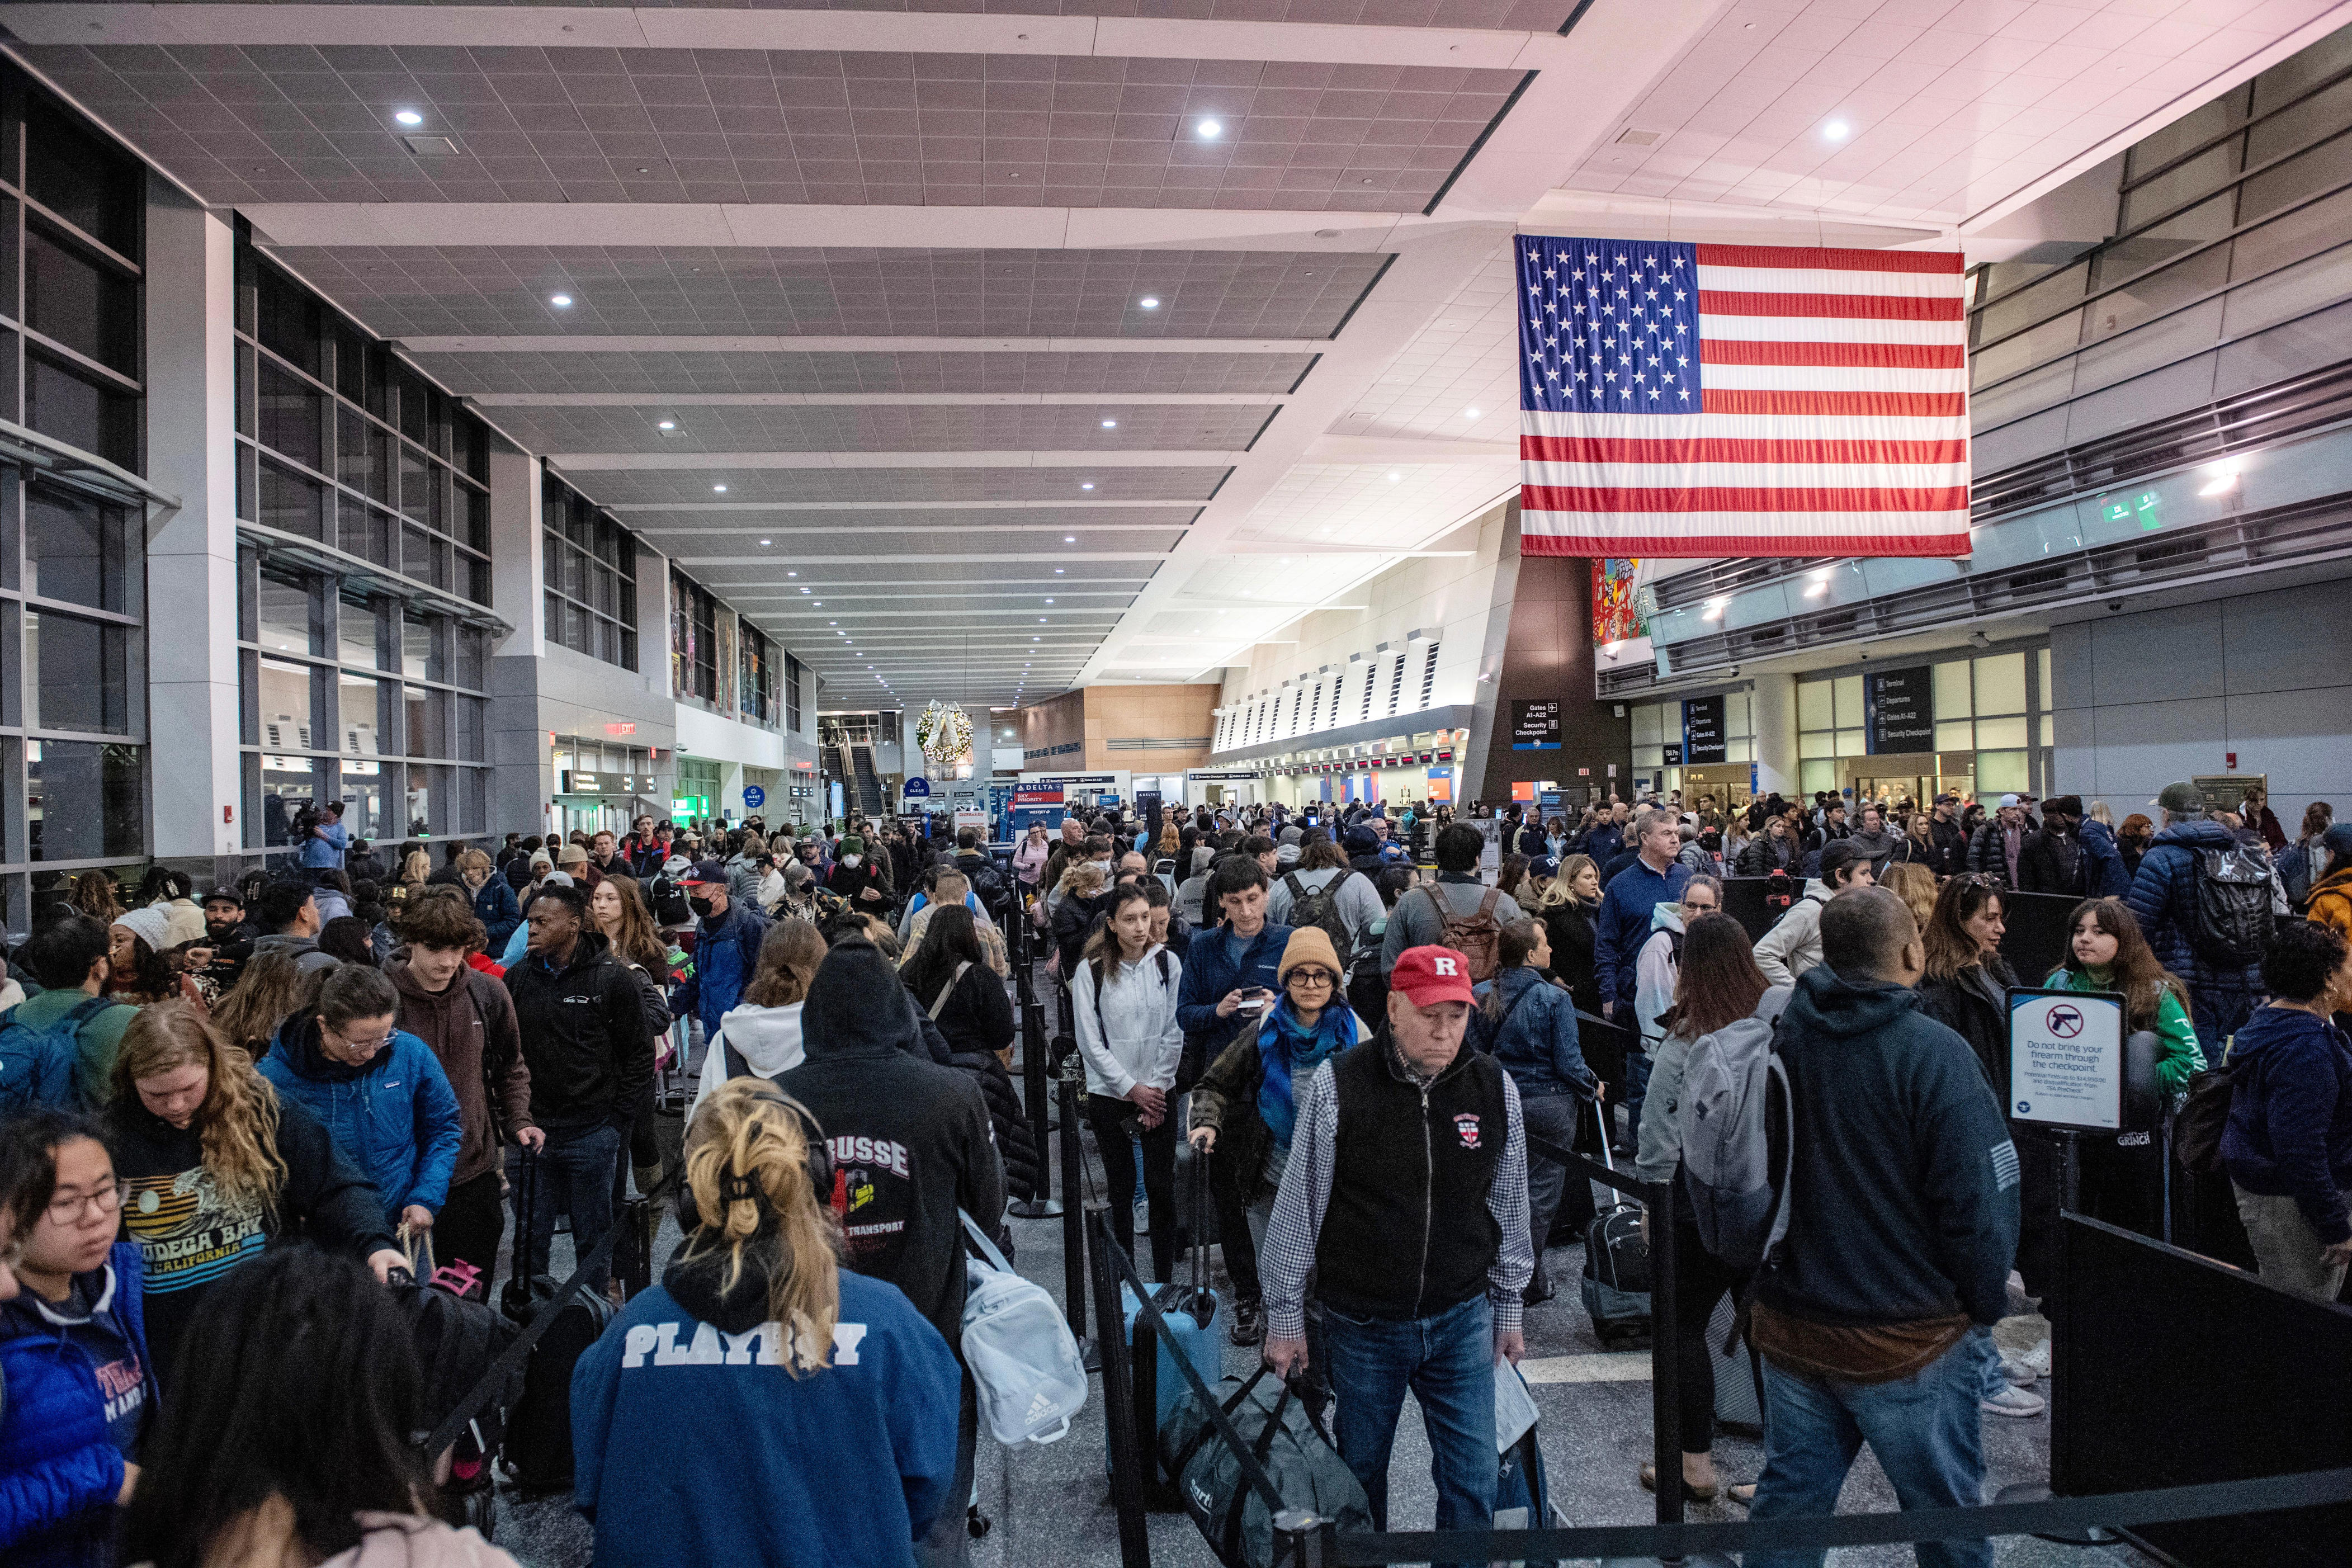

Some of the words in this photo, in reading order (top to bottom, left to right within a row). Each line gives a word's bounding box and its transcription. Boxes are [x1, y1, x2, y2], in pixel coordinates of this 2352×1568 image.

[1434, 957, 1458, 976] R
[2027, 1041, 2039, 1049] Do
[2058, 1043, 2081, 1053] bring
[2031, 1050, 2063, 1060] firearm
[2065, 1054, 2100, 1063] through
[2033, 1060, 2047, 1069] the
[2049, 1062, 2098, 1073] checkpoint.
[2117, 1131, 2150, 1146] GRINCH
[848, 1220, 905, 1236] TRANSPORT
[154, 1242, 241, 1273] CALIFORNIA
[622, 1321, 867, 1368] PLAYBY
[1025, 1403, 1059, 1425] adidas
